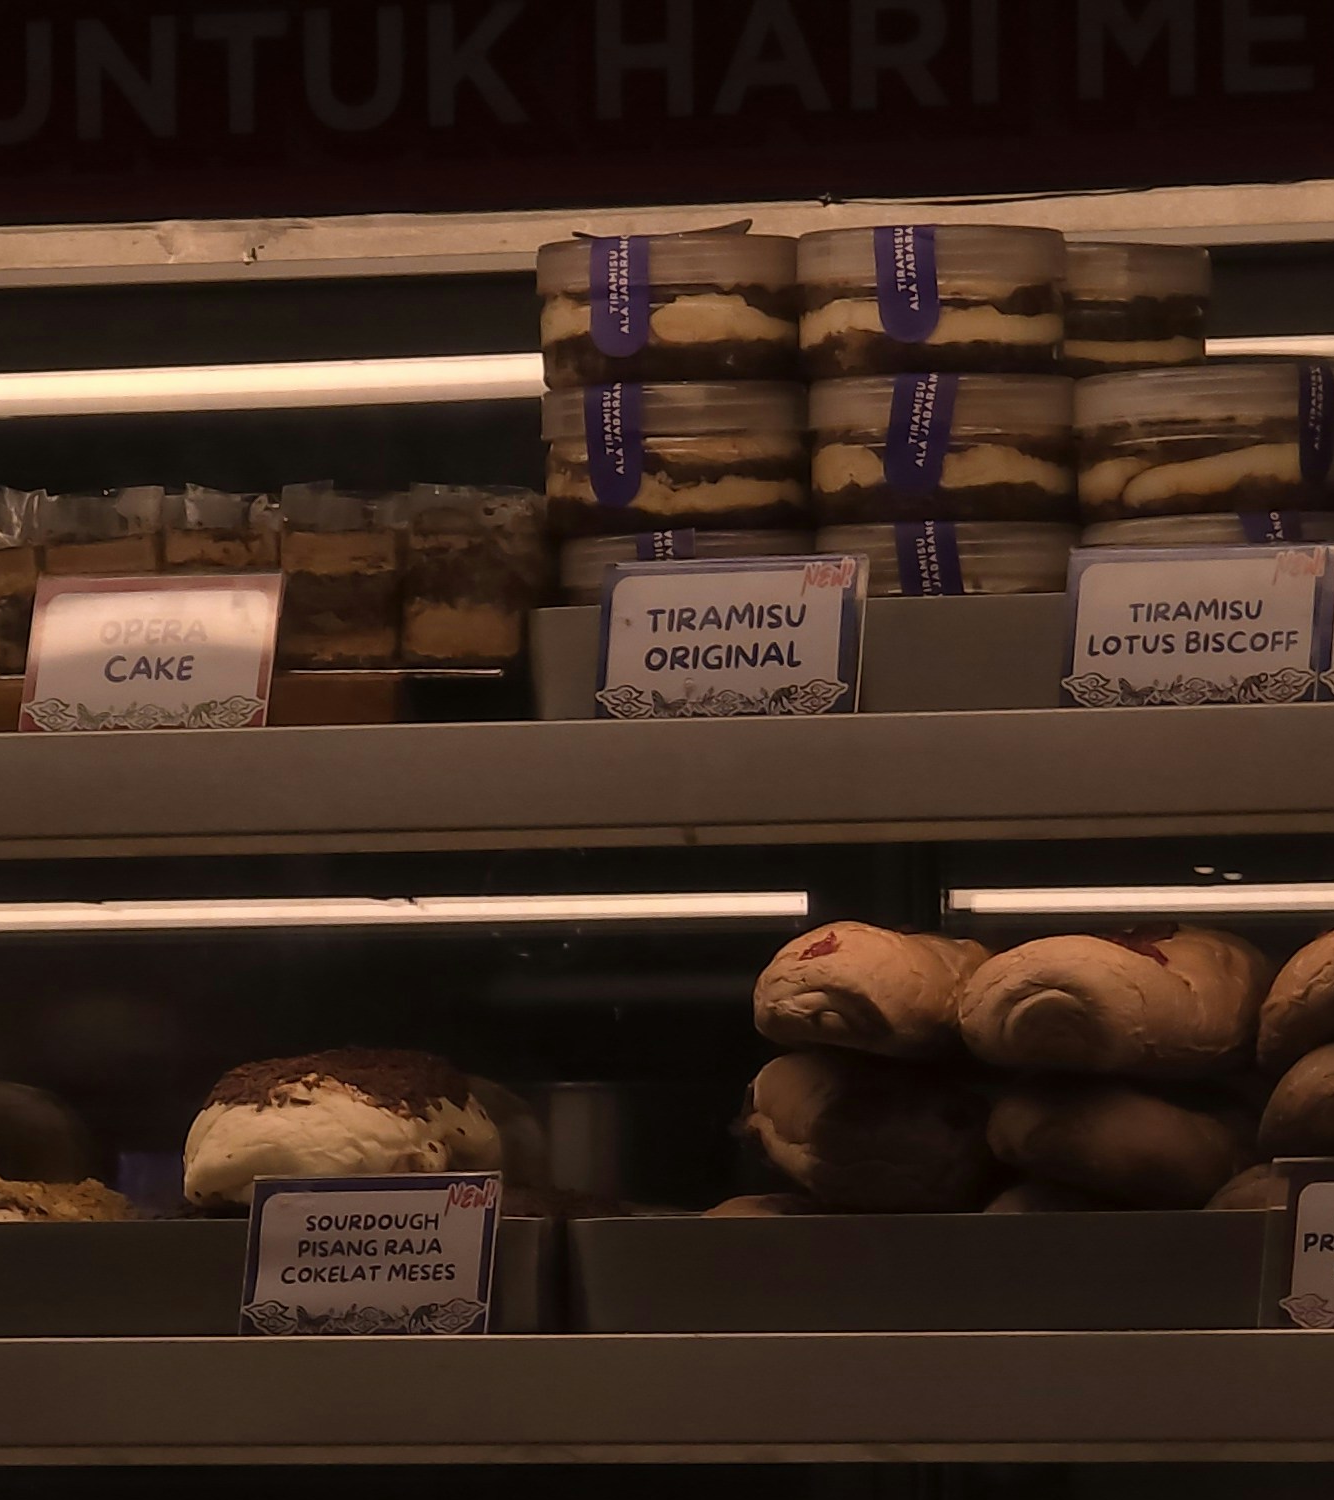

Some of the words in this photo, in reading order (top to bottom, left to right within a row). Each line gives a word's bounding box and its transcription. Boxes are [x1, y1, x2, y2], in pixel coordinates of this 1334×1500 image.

[594, 0, 1000, 121] HARI
[894, 227, 907, 292] TIRAMISU
[608, 250, 619, 314] TIRAMISU
[908, 283, 919, 311] ALA
[619, 306, 629, 334] ALA
[602, 390, 615, 455] TIRAMISU
[908, 381, 926, 444] TIRAMISU
[615, 447, 625, 475] ALA
[914, 440, 927, 468] ALA
[915, 537, 932, 593] IRAMISU
[647, 602, 806, 632] TIRAMISU
[1129, 599, 1263, 623] TIRAMISU
[99, 618, 208, 645] OPERA
[1088, 634, 1175, 656] LOTUS
[1184, 630, 1299, 653] BISCOFF
[104, 655, 194, 682] CAKE
[645, 641, 801, 670] ORIGINAL
[306, 1213, 439, 1232] SOURDOUGH
[298, 1239, 377, 1257] PISANG
[384, 1238, 442, 1256] RAJA
[281, 1266, 381, 1284] COKELAT
[388, 1263, 455, 1282] MESES
